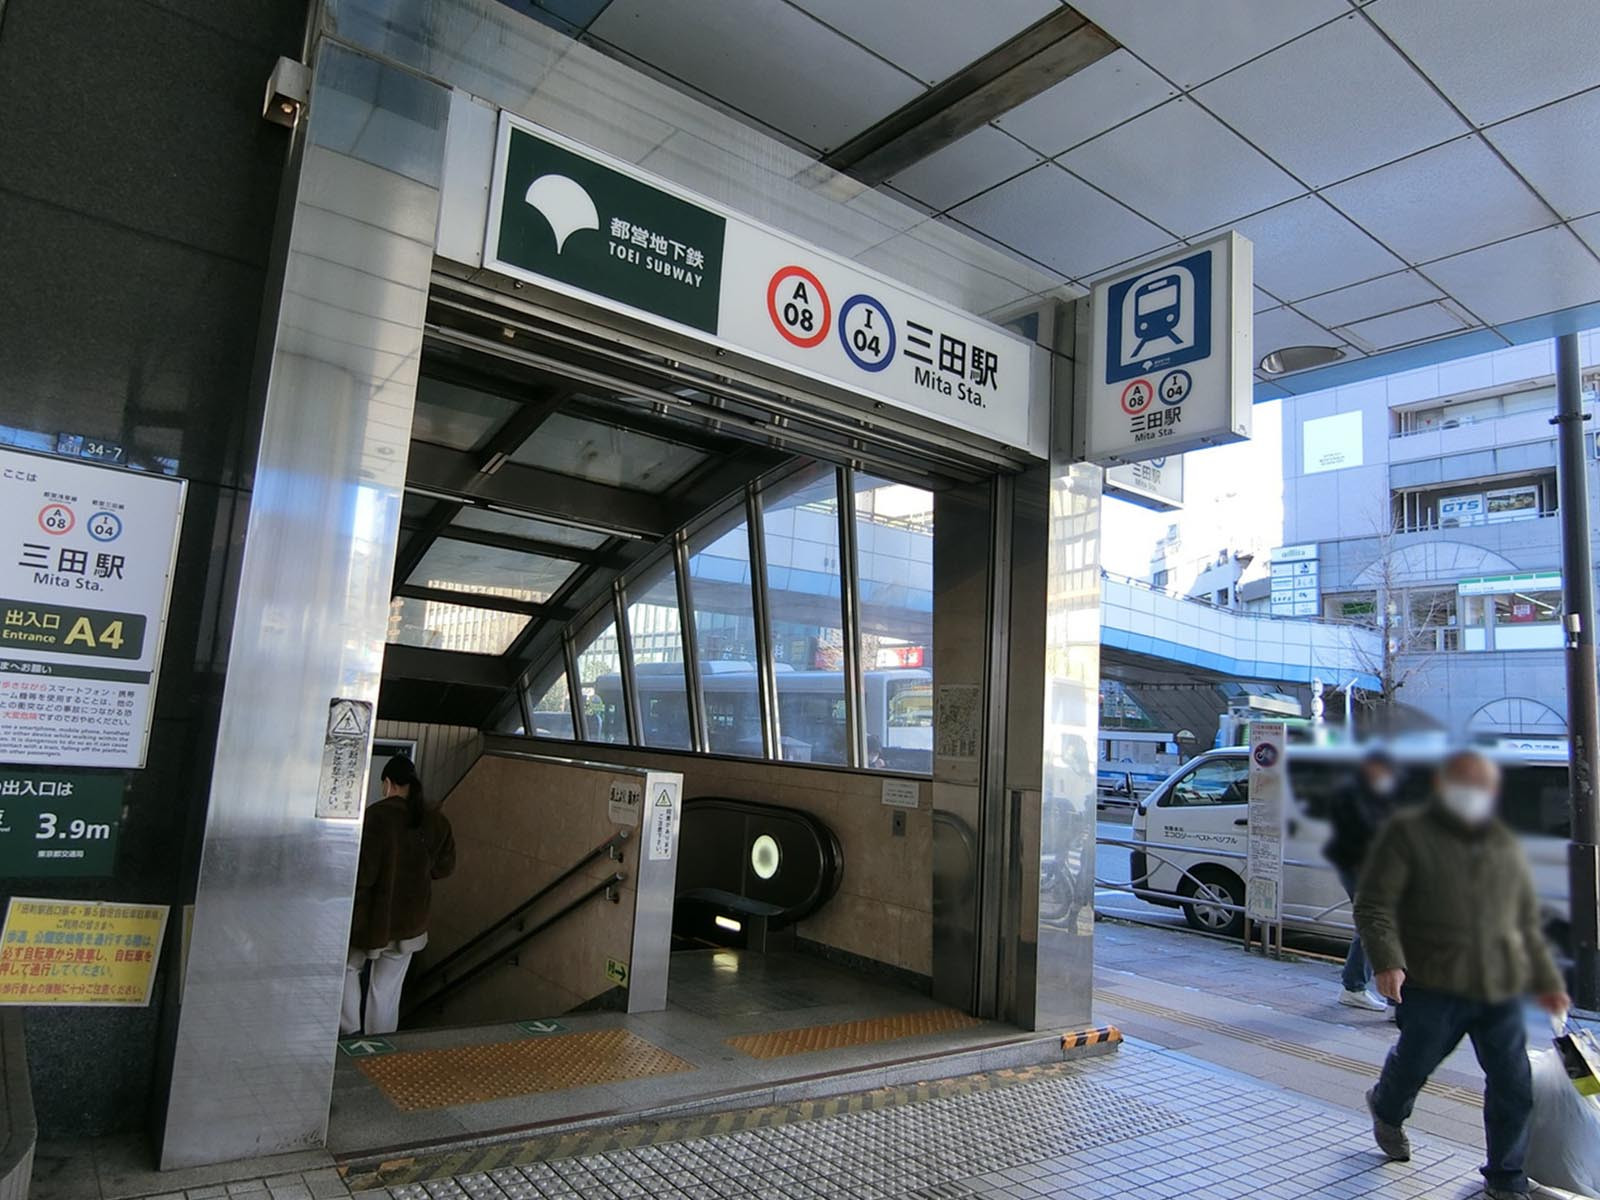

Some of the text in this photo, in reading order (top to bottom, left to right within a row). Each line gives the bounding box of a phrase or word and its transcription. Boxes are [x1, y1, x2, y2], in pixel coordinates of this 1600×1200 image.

[609, 217, 705, 270] 都営地下鉄
[608, 241, 703, 288] TOEI SUBWAY
[792, 281, 808, 304] A
[784, 303, 814, 332] 08
[863, 308, 873, 329] I
[853, 329, 881, 357] 04
[903, 320, 998, 391] 三田駅
[914, 366, 986, 408] Mita Sta.
[1172, 375, 1178, 386] I
[1132, 386, 1142, 396] A
[1166, 386, 1183, 399] 04
[1129, 395, 1144, 408] 08
[1130, 406, 1182, 433] 三田駅
[1134, 427, 1176, 443] Mita Sta.
[87, 442, 122, 461] 34-7
[3, 468, 38, 482] ここは
[53, 508, 62, 517] A
[1443, 501, 1479, 513] GTS
[46, 516, 66, 529] 08
[94, 525, 114, 537] 04
[18, 543, 125, 580] 三田駅
[33, 572, 104, 592] Mita Sta.
[5, 609, 61, 630] 出入口
[2, 629, 57, 644] Entrance
[63, 616, 125, 650] A4
[0, 779, 74, 797] 出入口は
[35, 813, 110, 839] 3.9m
